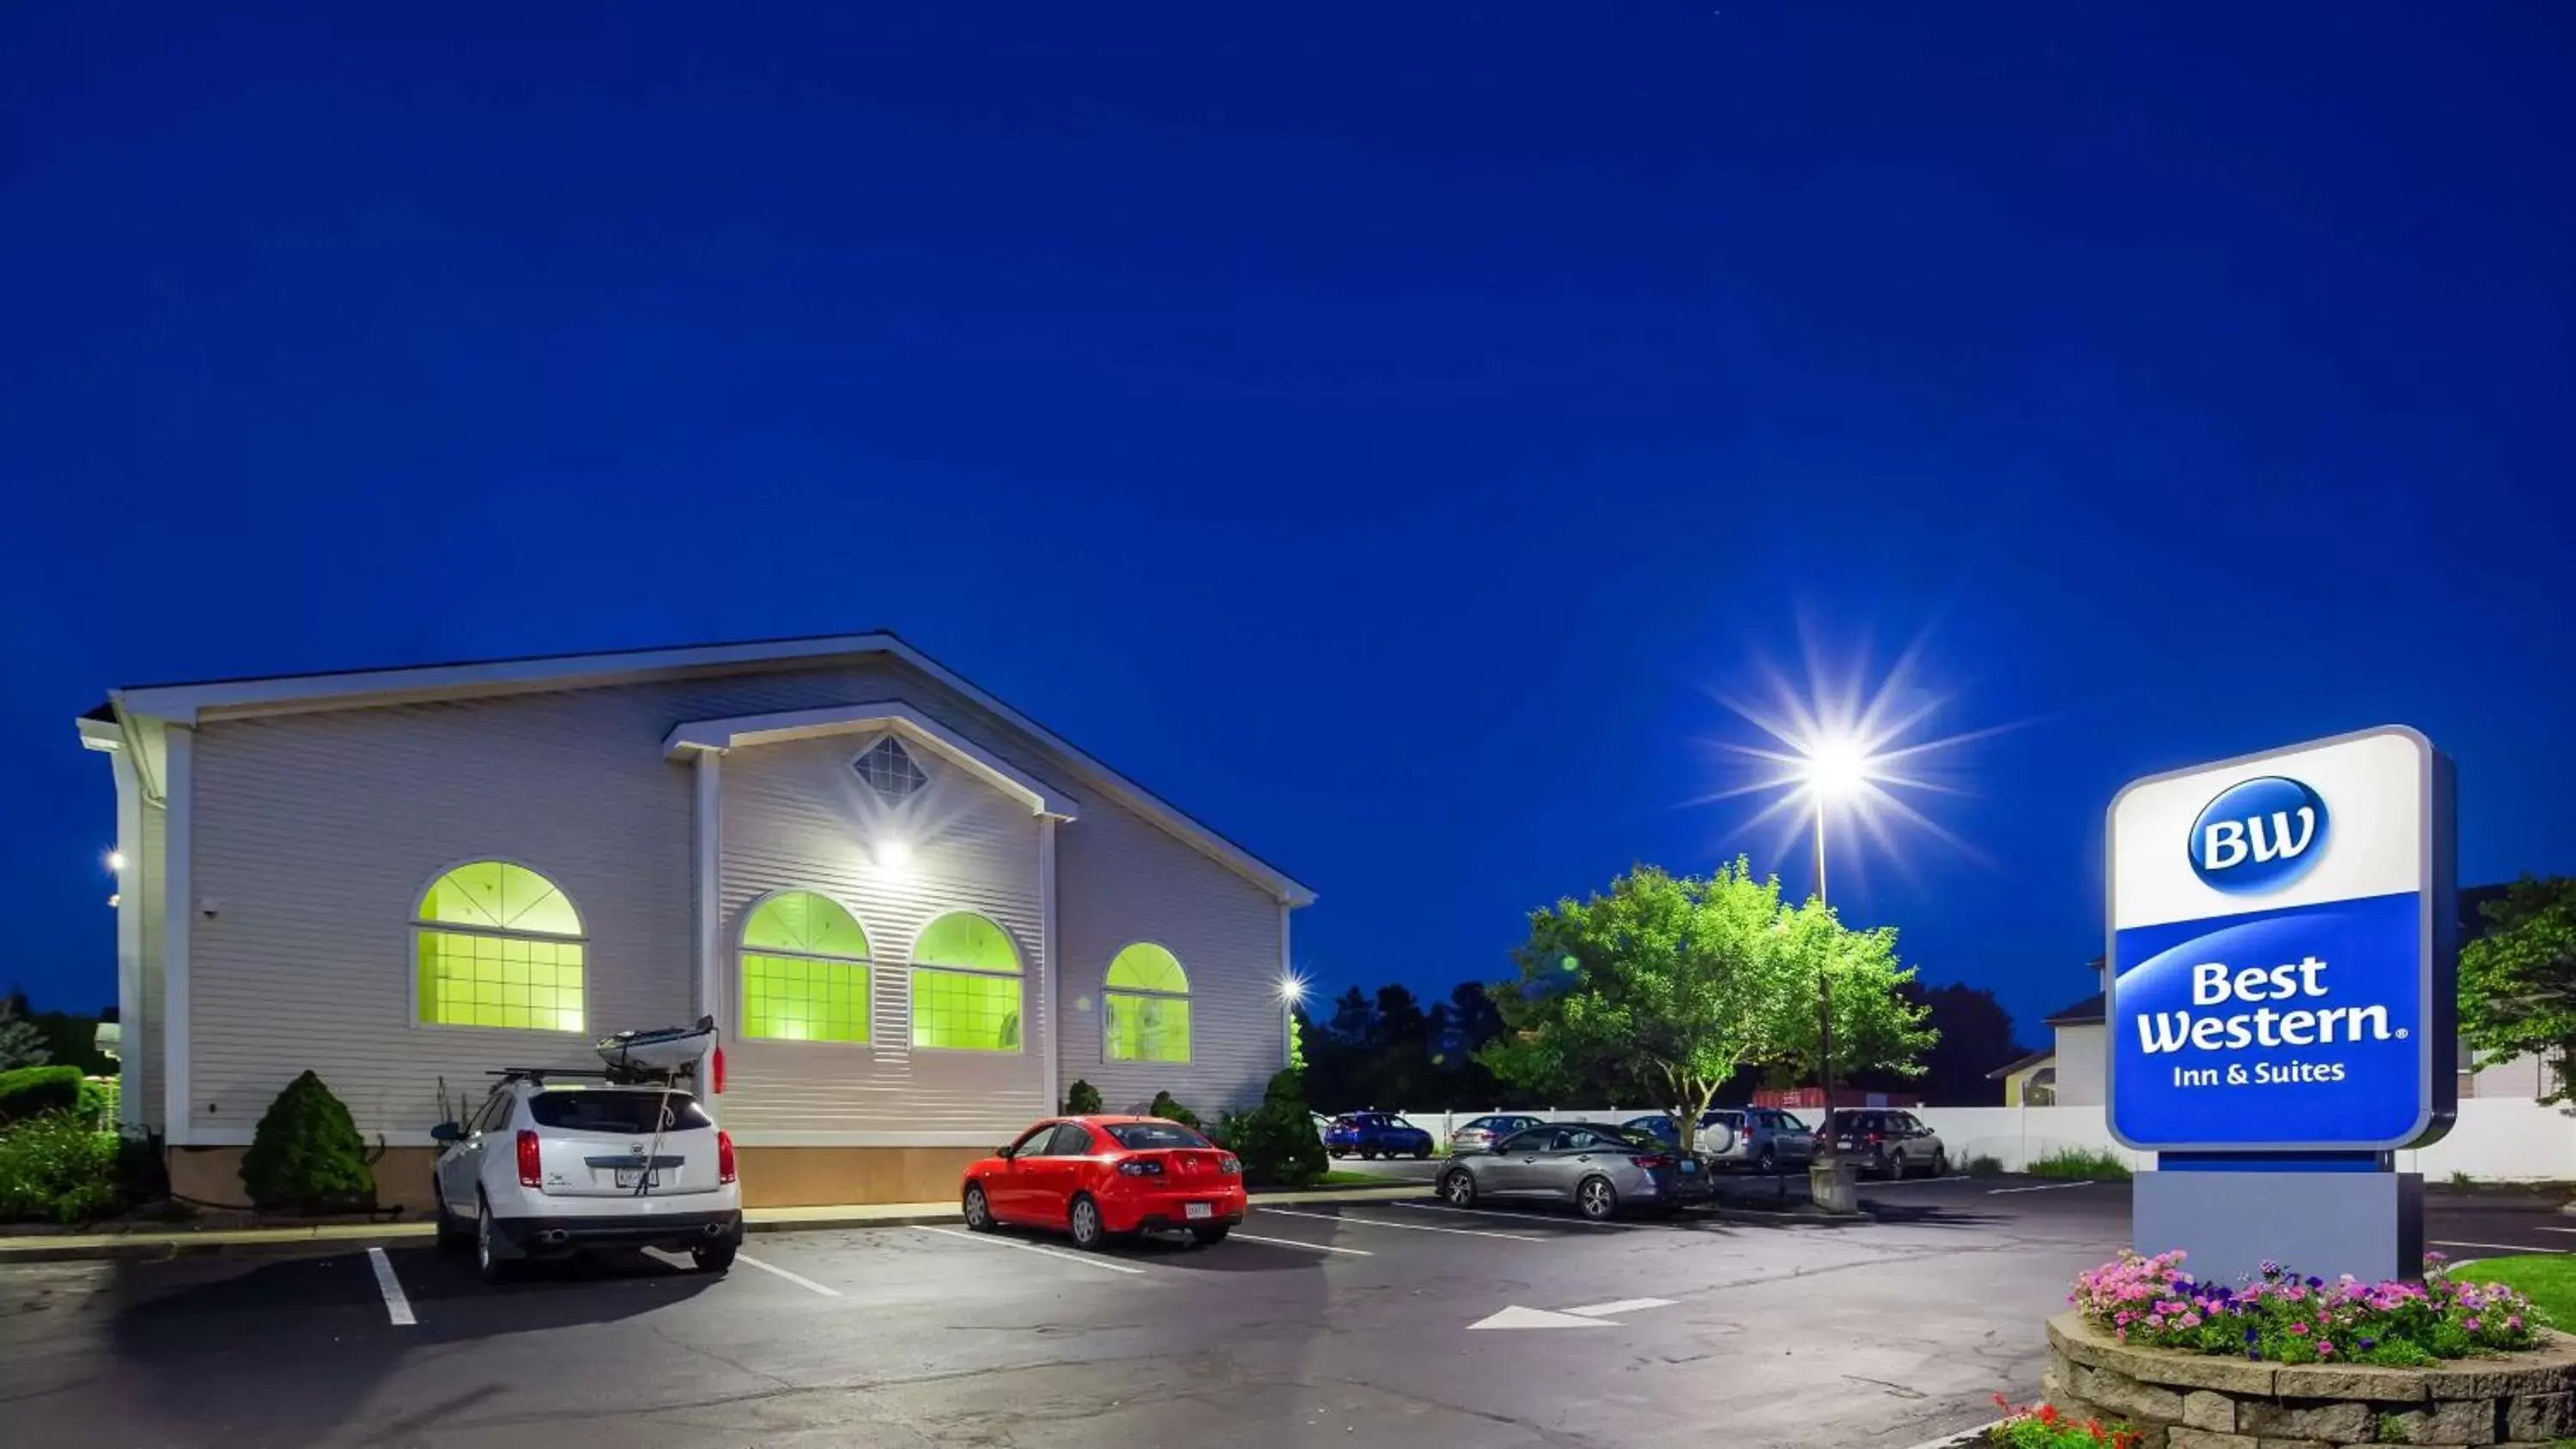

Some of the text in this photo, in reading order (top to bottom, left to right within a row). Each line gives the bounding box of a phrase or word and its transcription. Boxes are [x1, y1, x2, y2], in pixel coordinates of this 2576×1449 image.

[2204, 806, 2315, 870] BW
[2192, 955, 2329, 1005] Best
[2173, 1060, 2346, 1087] Inn & Suites
